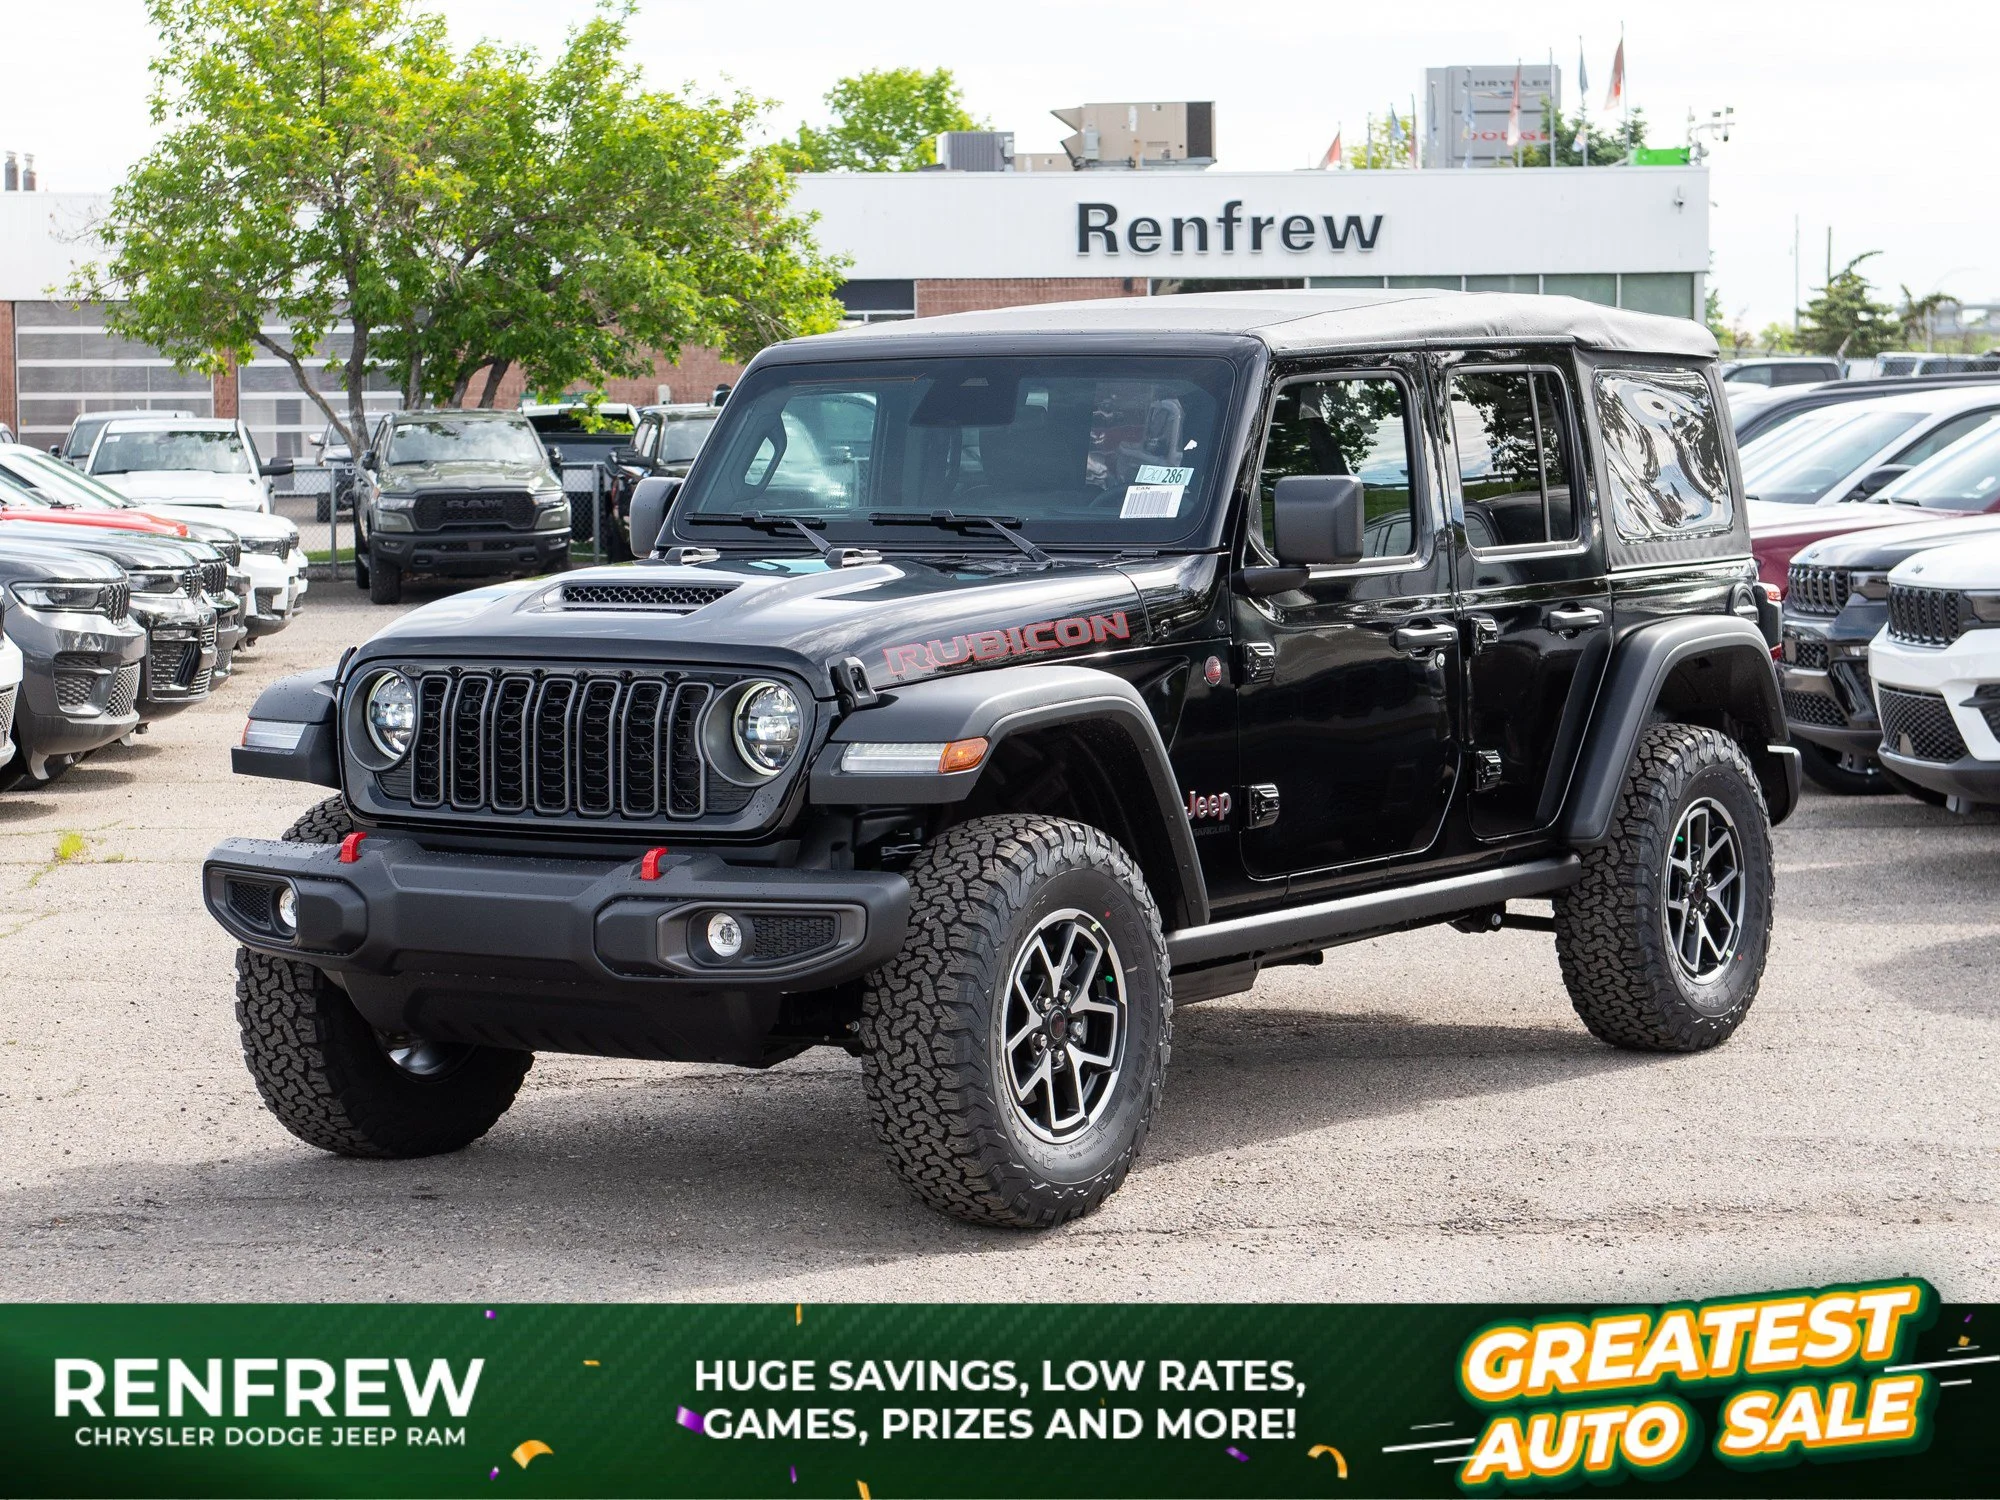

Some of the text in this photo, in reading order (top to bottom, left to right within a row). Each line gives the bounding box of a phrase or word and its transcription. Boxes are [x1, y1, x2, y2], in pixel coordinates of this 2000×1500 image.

[1077, 200, 1384, 255] Renfrew
[1162, 468, 1184, 483] 286
[446, 499, 503, 509] RAM
[883, 611, 1131, 675] RUBICON
[1184, 790, 1232, 821] Jeep
